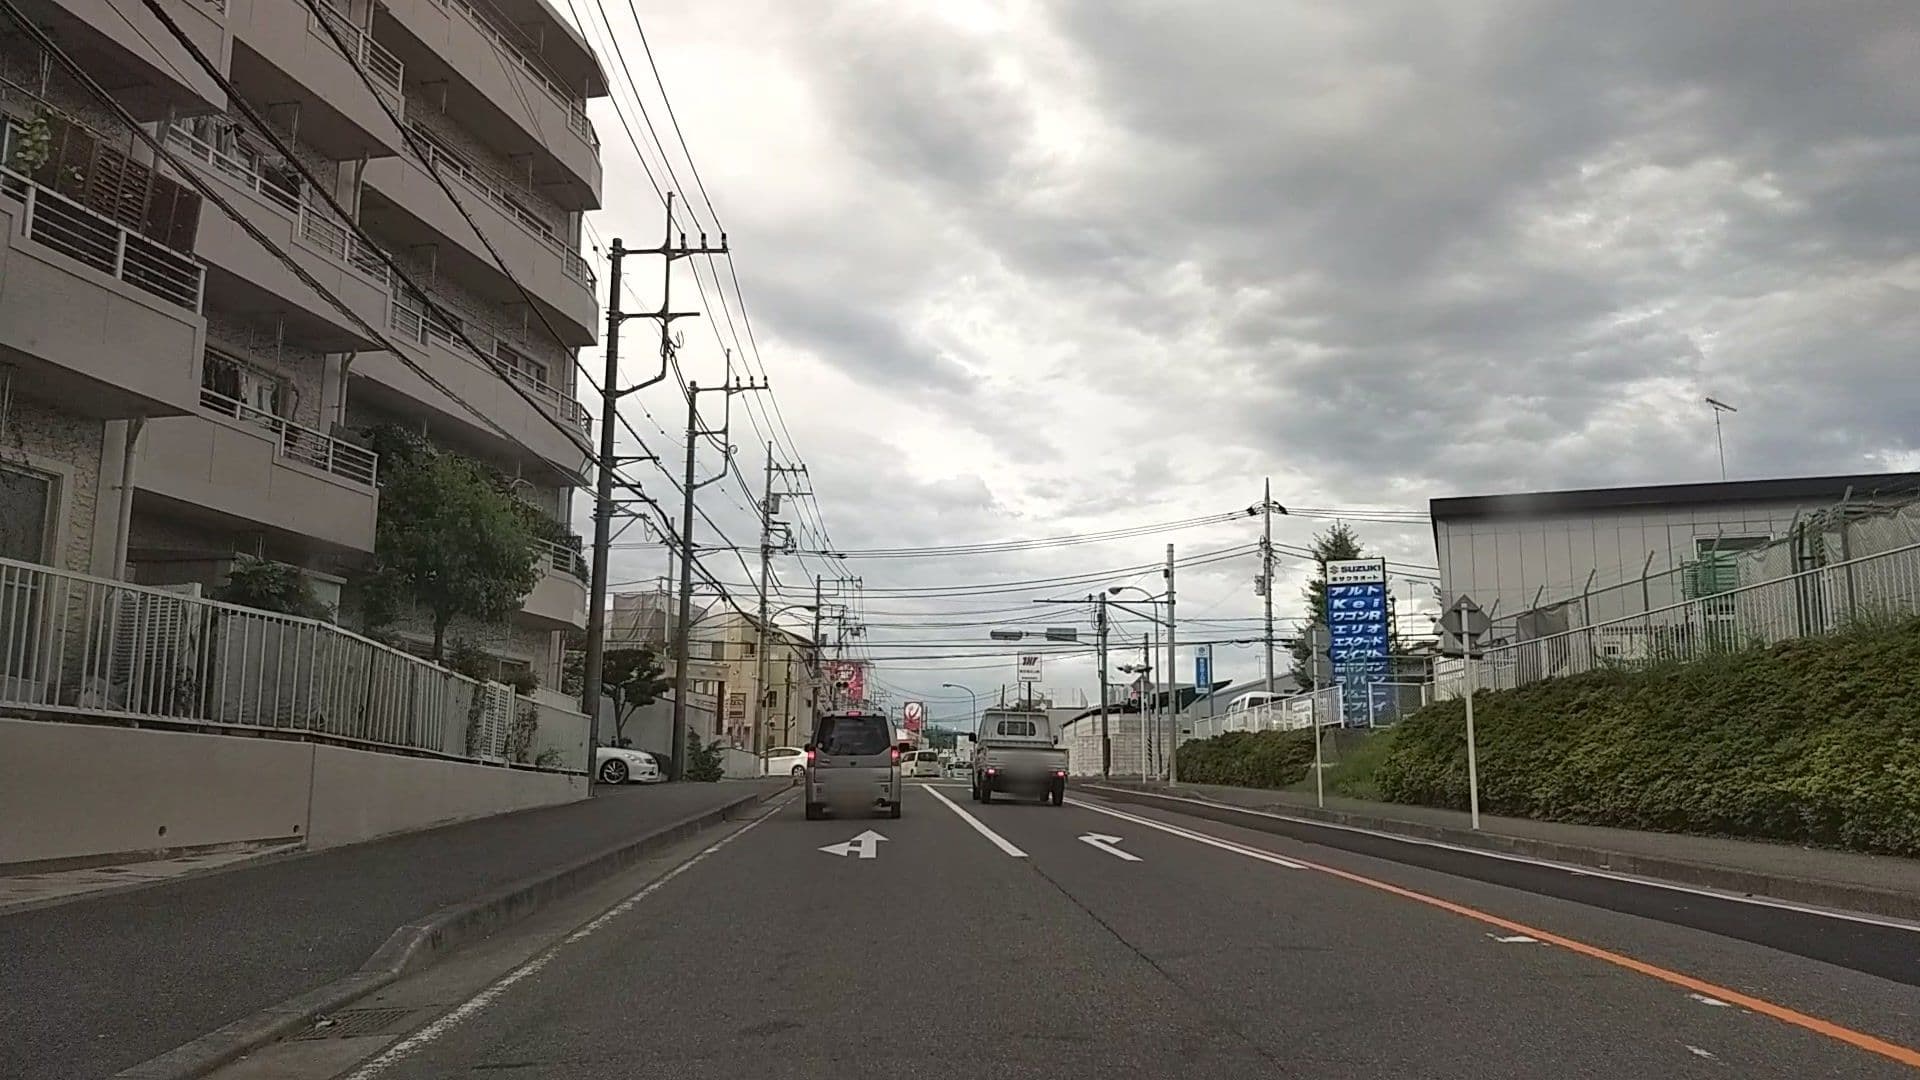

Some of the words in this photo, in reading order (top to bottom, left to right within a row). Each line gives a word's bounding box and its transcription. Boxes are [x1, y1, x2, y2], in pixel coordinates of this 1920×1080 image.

[1341, 565, 1381, 573] SUZUKI
[1331, 586, 1380, 596] アルト
[1333, 599, 1380, 609] Kei
[1333, 611, 1381, 621] ワゴンR
[1334, 624, 1382, 634] エリオ
[1333, 637, 1384, 647] エスクード
